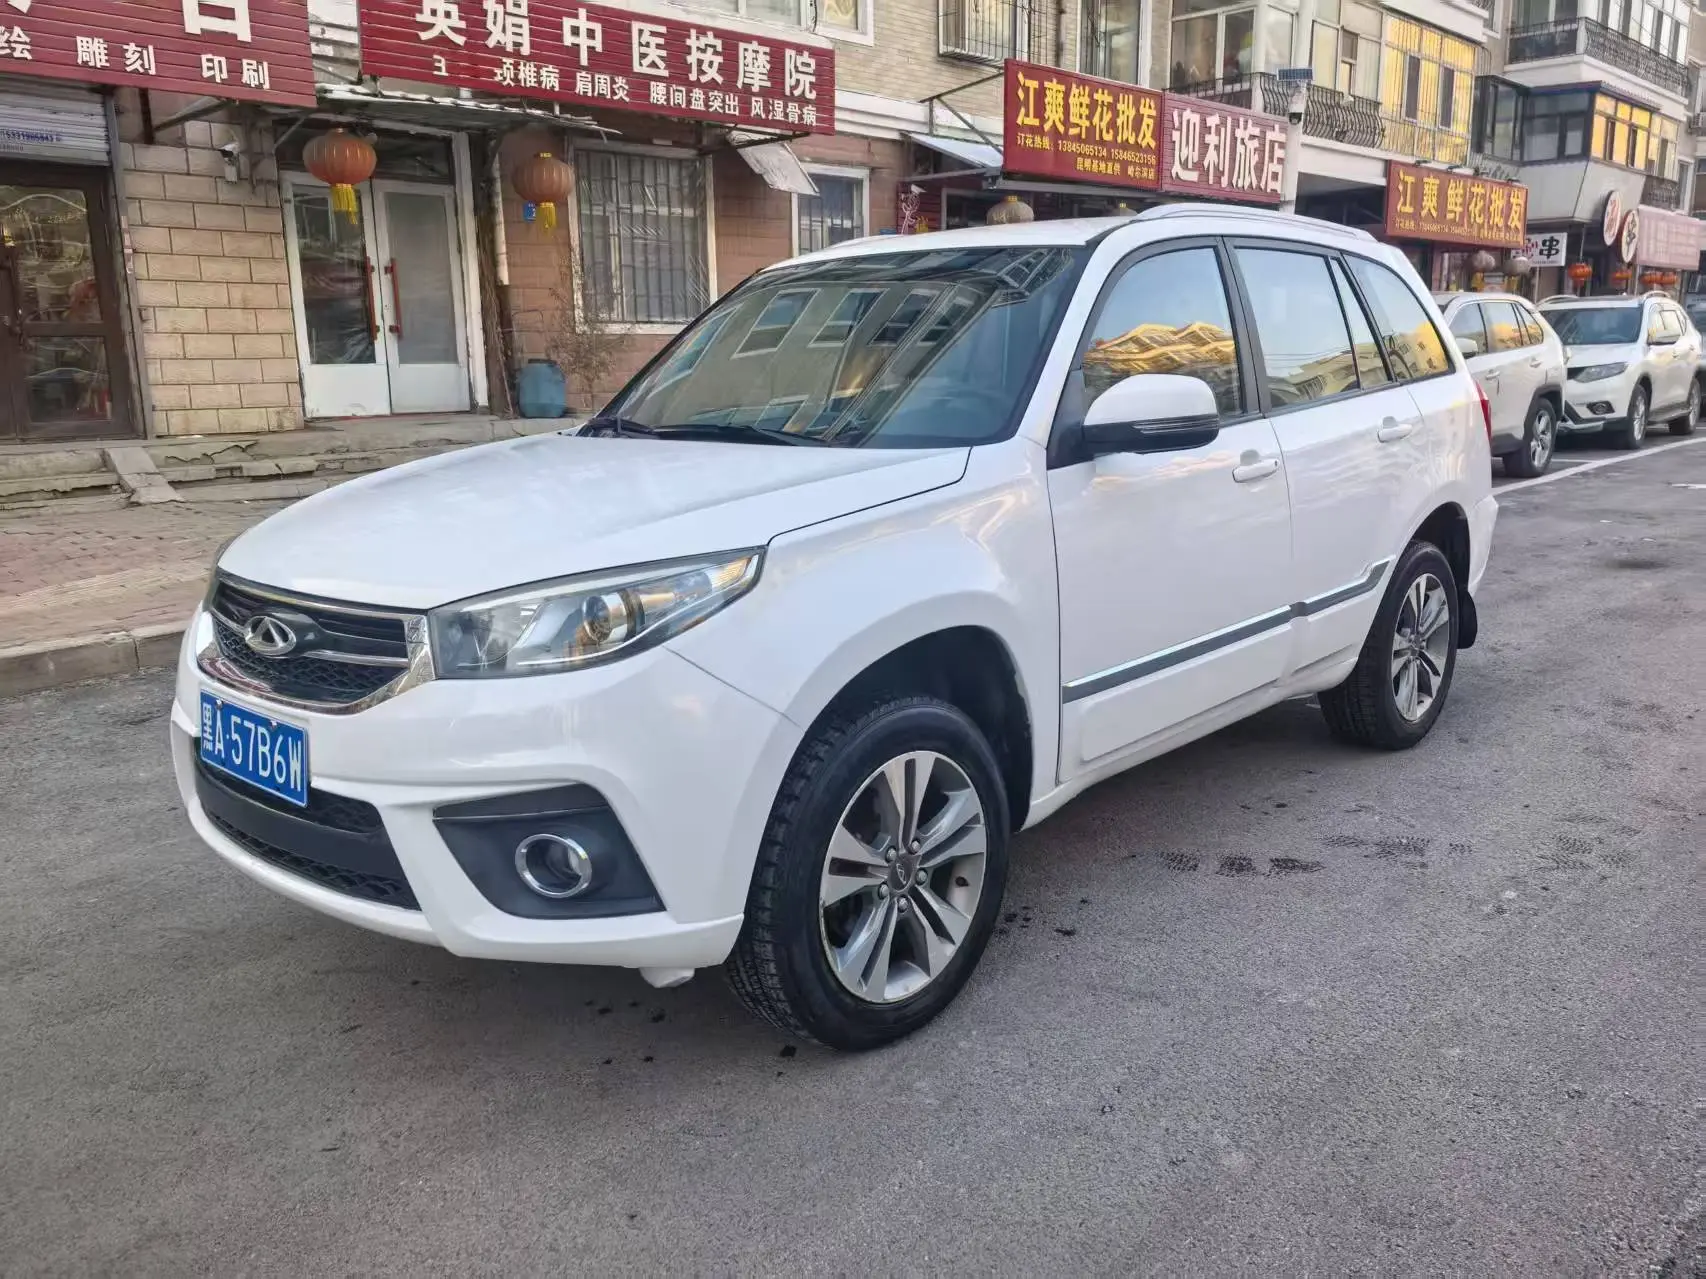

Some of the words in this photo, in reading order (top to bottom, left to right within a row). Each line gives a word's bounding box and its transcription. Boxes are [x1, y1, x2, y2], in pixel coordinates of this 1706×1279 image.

[76, 36, 156, 75] 雕刻
[200, 54, 270, 90] 印刷
[415, 0, 817, 100] 英娟中医按摩院
[574, 72, 630, 103] 肩周炎
[650, 81, 740, 117] 腰间盘突出
[750, 96, 818, 127] 风湿骨病
[1016, 71, 1157, 150] 江爽鲜花批发
[1172, 108, 1288, 194] 迎利旅店
[1397, 172, 1523, 230] 江爽鲜花批发
